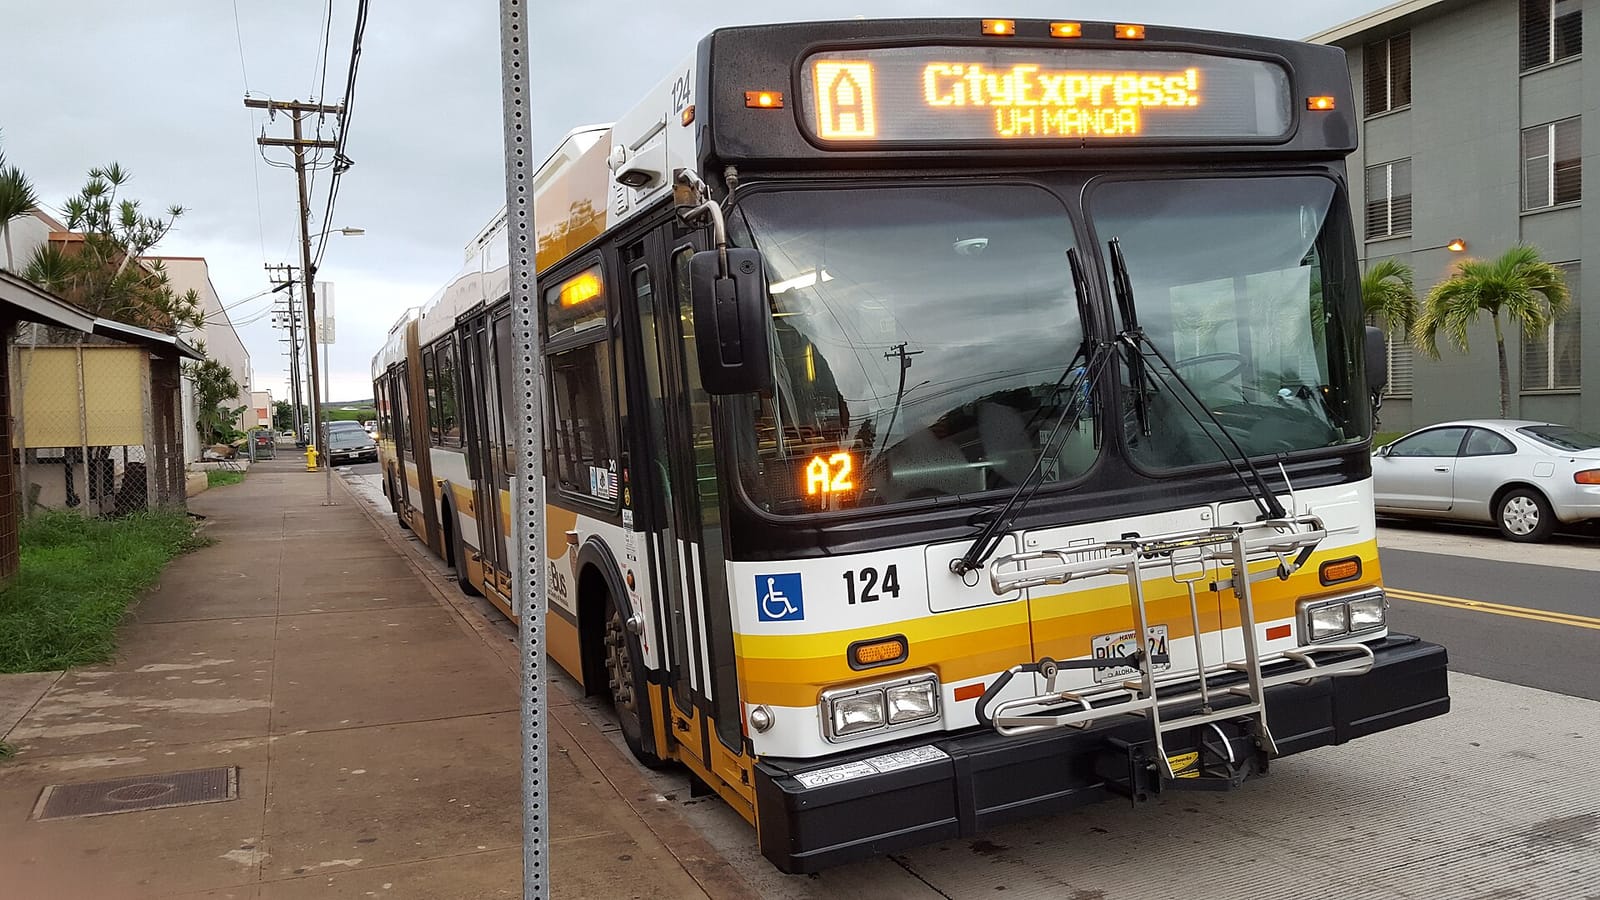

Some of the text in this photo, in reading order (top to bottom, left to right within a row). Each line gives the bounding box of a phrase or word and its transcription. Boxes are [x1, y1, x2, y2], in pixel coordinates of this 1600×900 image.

[671, 69, 691, 117] 124
[826, 66, 867, 134] A
[922, 63, 1199, 107] CityExpress!
[995, 106, 1138, 136] UH MANOA
[806, 452, 853, 495] A2
[842, 564, 900, 605] 124
